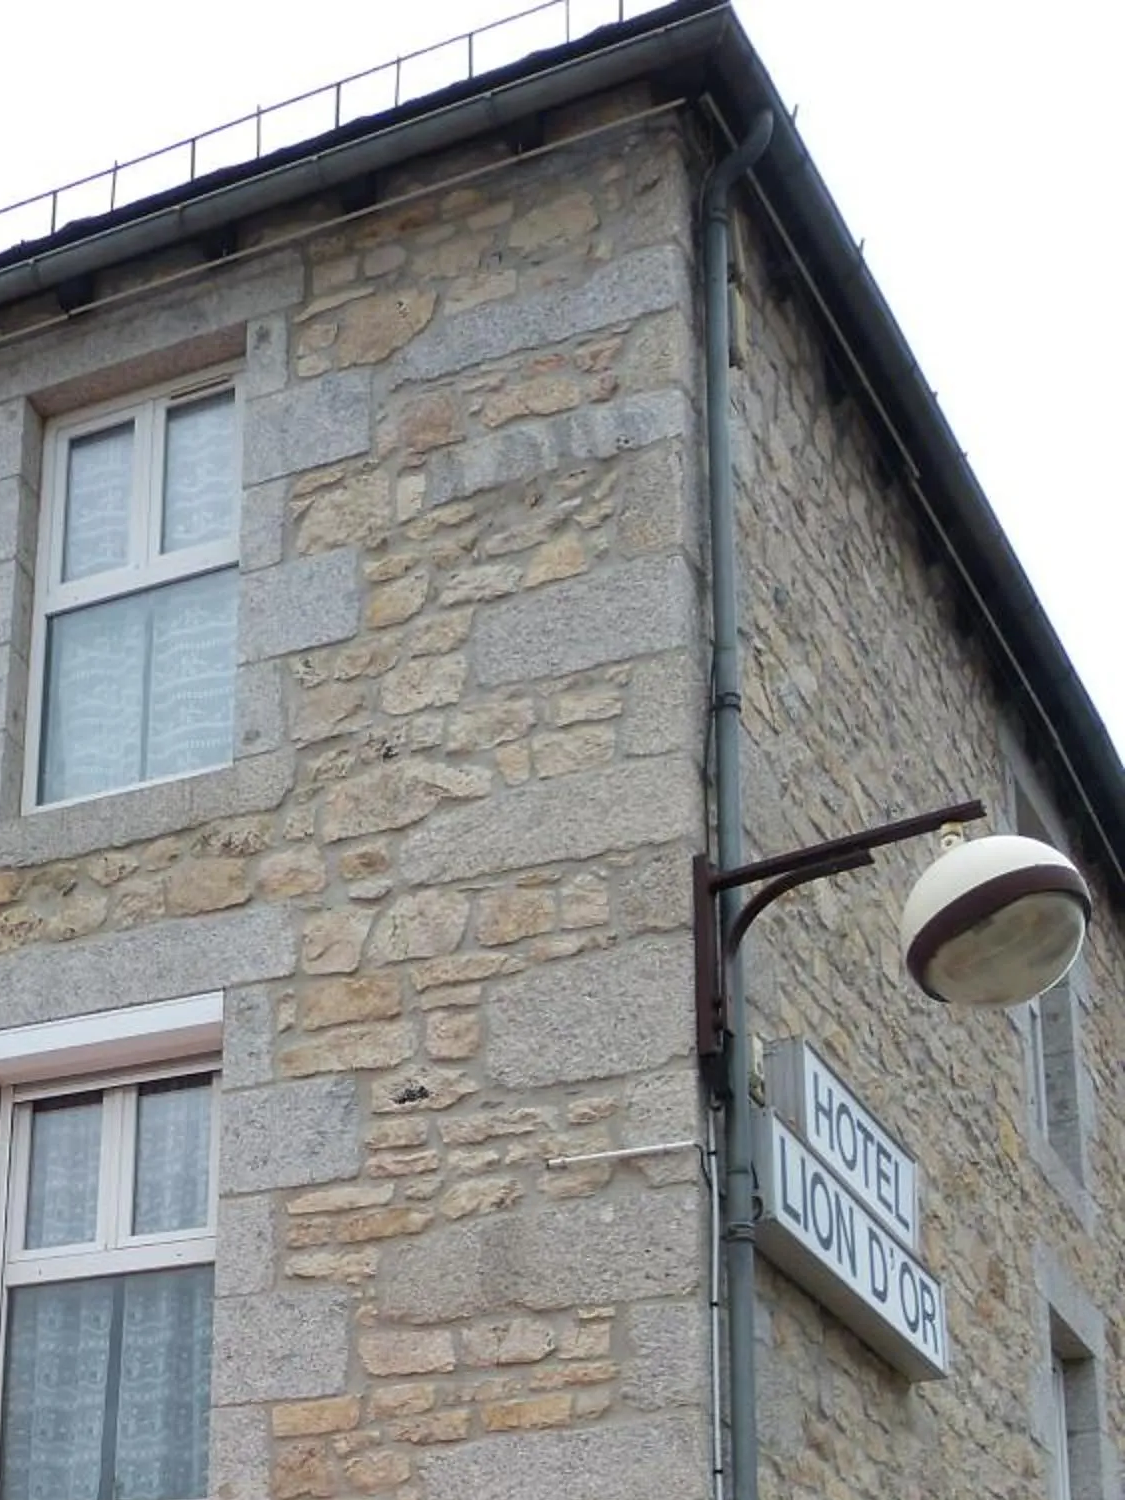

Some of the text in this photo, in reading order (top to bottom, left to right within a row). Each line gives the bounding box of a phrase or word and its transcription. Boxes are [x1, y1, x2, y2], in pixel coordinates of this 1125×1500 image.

[779, 1135, 939, 1355] LION D'OR
[813, 1071, 910, 1231] HOTEL
